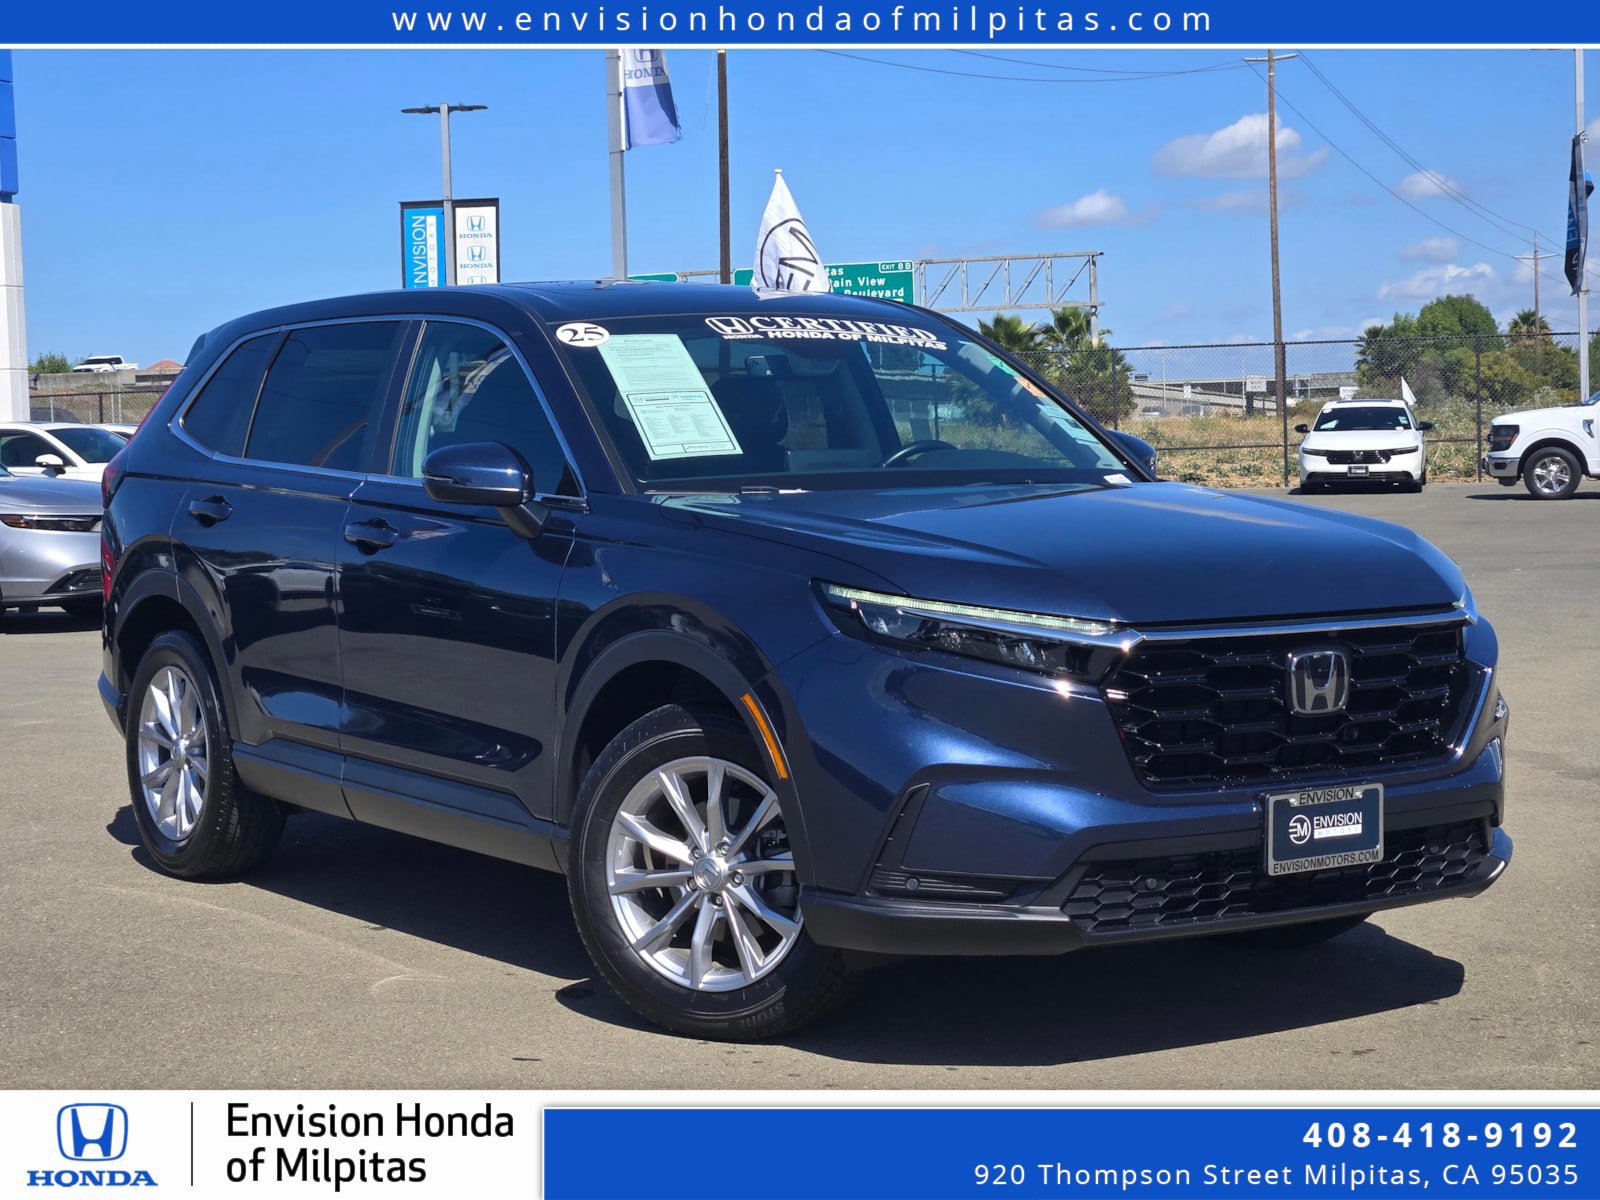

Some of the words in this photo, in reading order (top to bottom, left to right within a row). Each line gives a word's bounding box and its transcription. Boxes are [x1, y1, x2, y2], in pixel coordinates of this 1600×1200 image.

[411, 215, 428, 288] NVISION
[857, 277, 886, 286] View
[561, 326, 605, 343] 25
[749, 316, 938, 341] CERTIFIED
[767, 331, 836, 341] HONDA
[838, 333, 862, 341] OF
[867, 334, 948, 350] MILPITAS
[1299, 787, 1354, 805] ENVISION
[1313, 811, 1363, 829] ENVISION
[1273, 850, 1379, 874] ENVISIONMOTORS.COM
